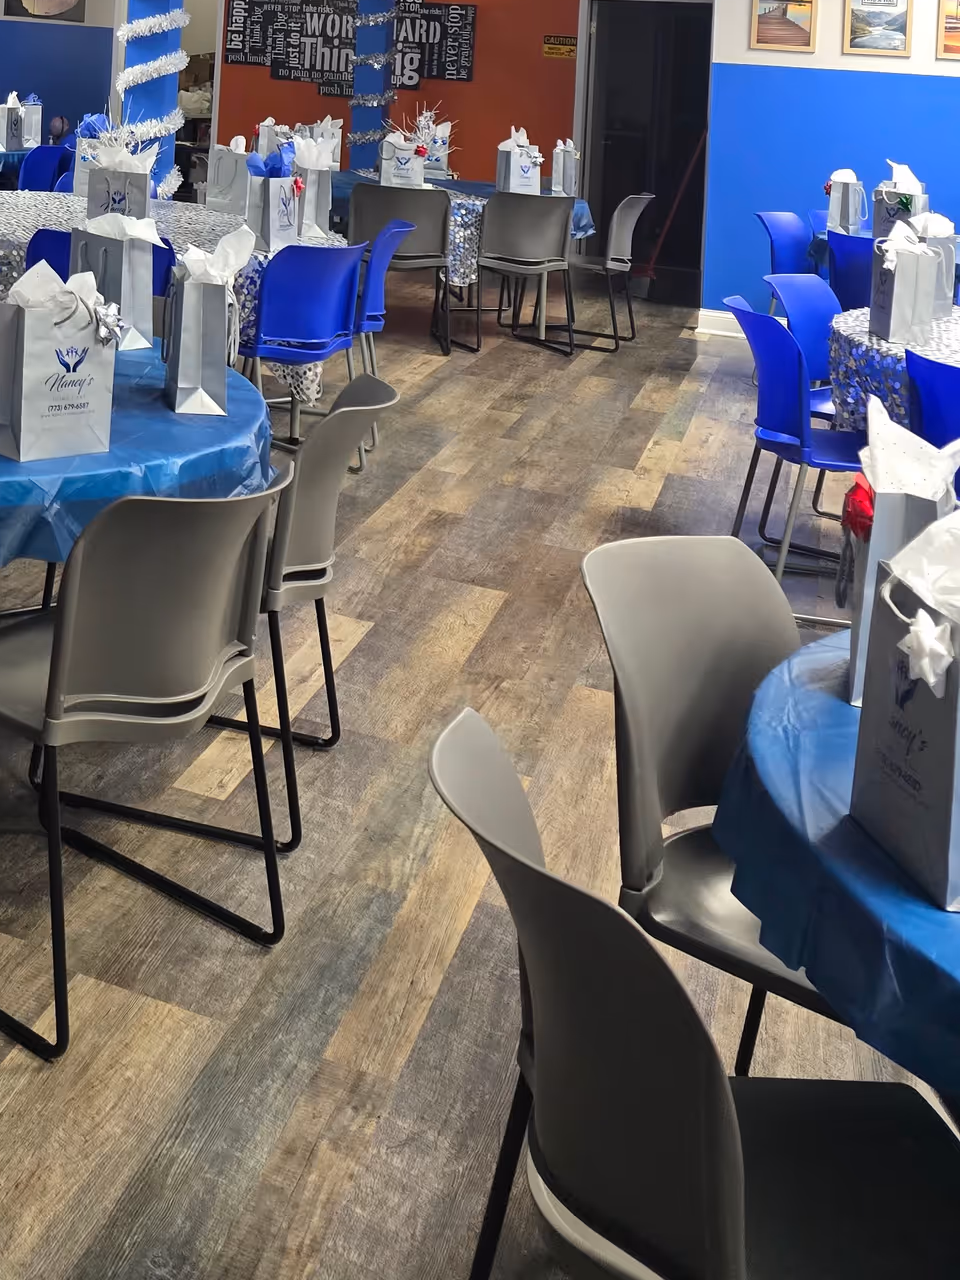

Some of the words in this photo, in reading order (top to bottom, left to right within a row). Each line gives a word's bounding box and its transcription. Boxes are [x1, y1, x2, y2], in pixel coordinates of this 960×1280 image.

[251, 6, 265, 22] Big
[263, 4, 282, 12] NEVER
[284, 4, 301, 13] STOP
[302, 3, 317, 13] take
[317, 4, 334, 14] risks
[274, 11, 288, 29] Big
[288, 21, 301, 31] it
[445, 5, 465, 34] stop
[250, 23, 262, 47] Think
[306, 13, 354, 38] WOR
[393, 18, 441, 43] ARD
[226, 33, 243, 50] be
[272, 31, 286, 60] Think
[287, 32, 300, 46] do
[544, 36, 577, 45] CAUTION
[285, 46, 301, 69] just
[301, 36, 354, 72] Thin
[459, 32, 472, 67] grateful
[228, 52, 245, 64] push
[247, 53, 267, 64] limits
[445, 38, 459, 80] never
[278, 68, 289, 76] no
[291, 68, 309, 79] pain
[311, 71, 321, 79] no
[323, 71, 342, 82] gain
[456, 68, 468, 79] be
[320, 85, 340, 95] push
[44, 372, 95, 395] Nancy's
[48, 404, 63, 413] (773)
[63, 402, 89, 411] 679-6587
